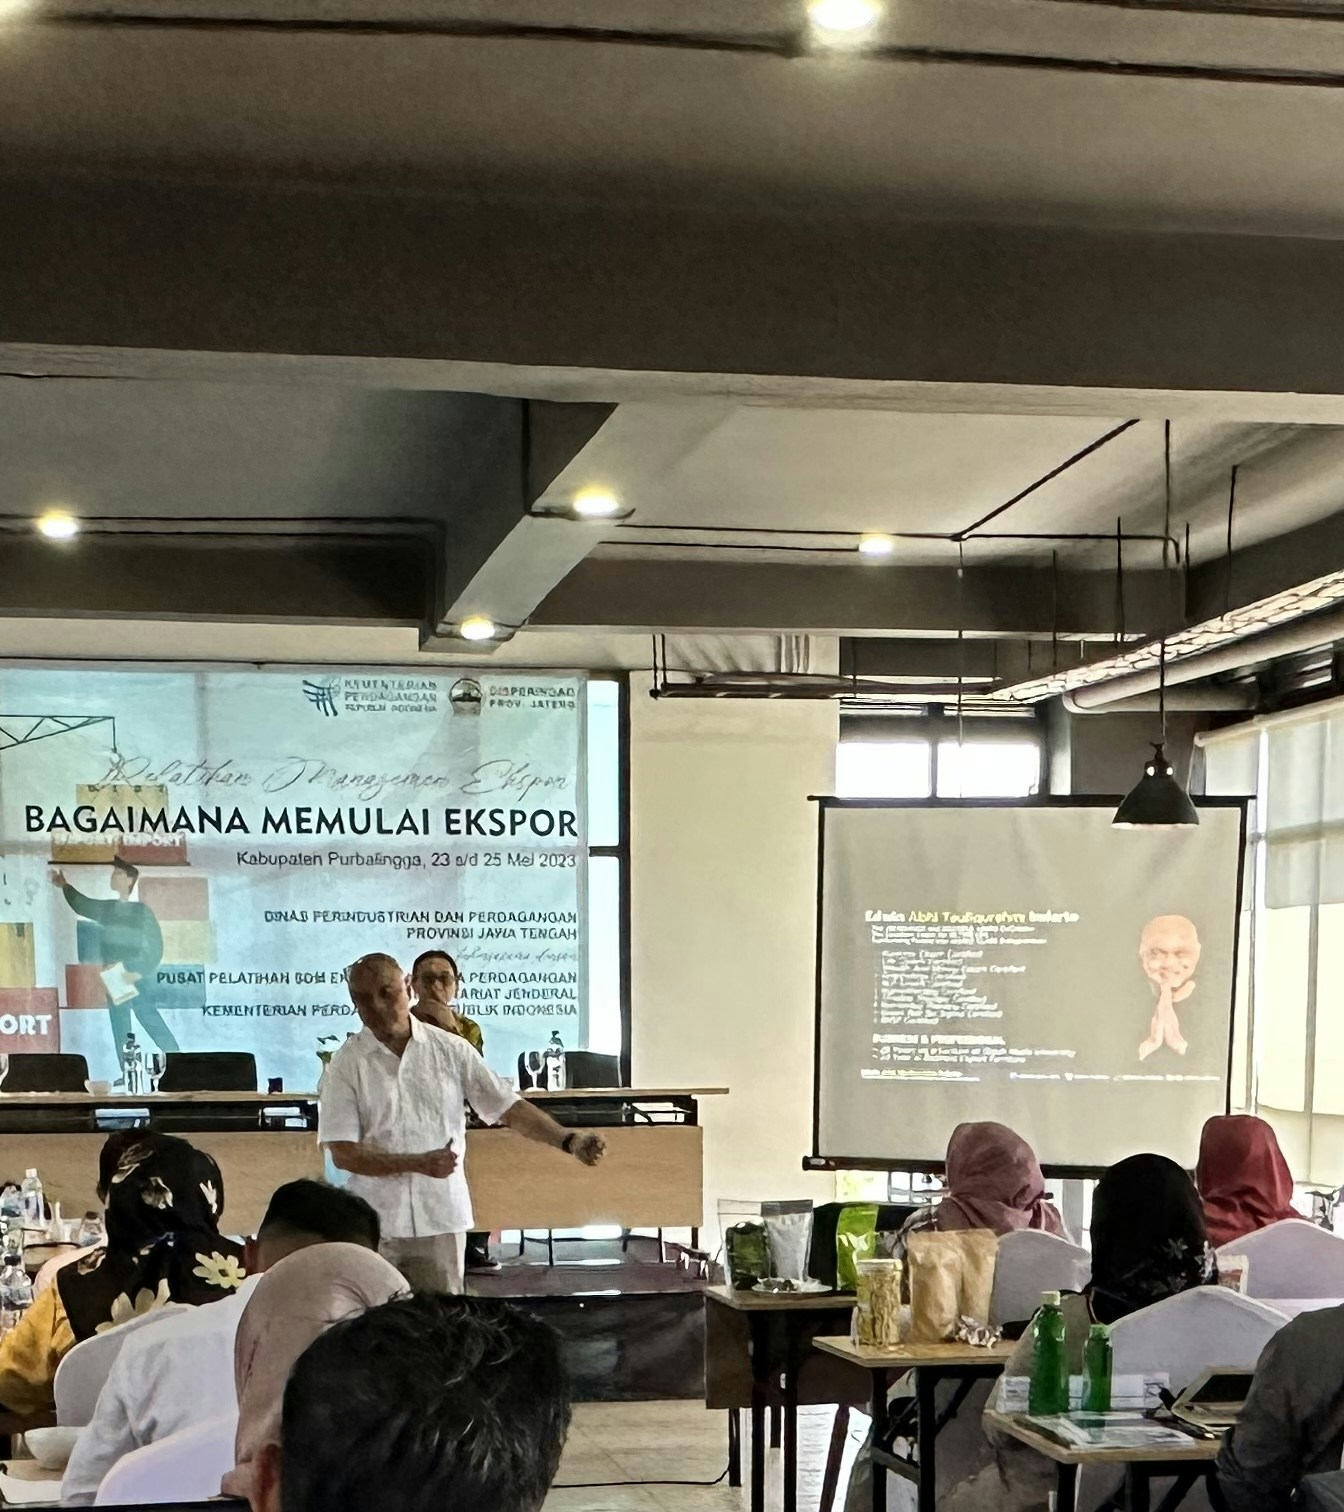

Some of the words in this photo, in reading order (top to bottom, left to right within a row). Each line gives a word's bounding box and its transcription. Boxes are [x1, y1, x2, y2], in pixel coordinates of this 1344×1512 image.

[25, 805, 251, 834] BAGAIMANA
[261, 806, 430, 836] MEMULAI
[444, 808, 578, 837] EKSPOR
[236, 851, 323, 869] Kabupaten
[431, 852, 450, 868] 23
[483, 852, 502, 868] 25
[538, 853, 576, 868] 2023
[520, 927, 578, 941] TENGAH
[156, 971, 205, 985] PUSAT
[209, 971, 290, 985] PELATIHAN
